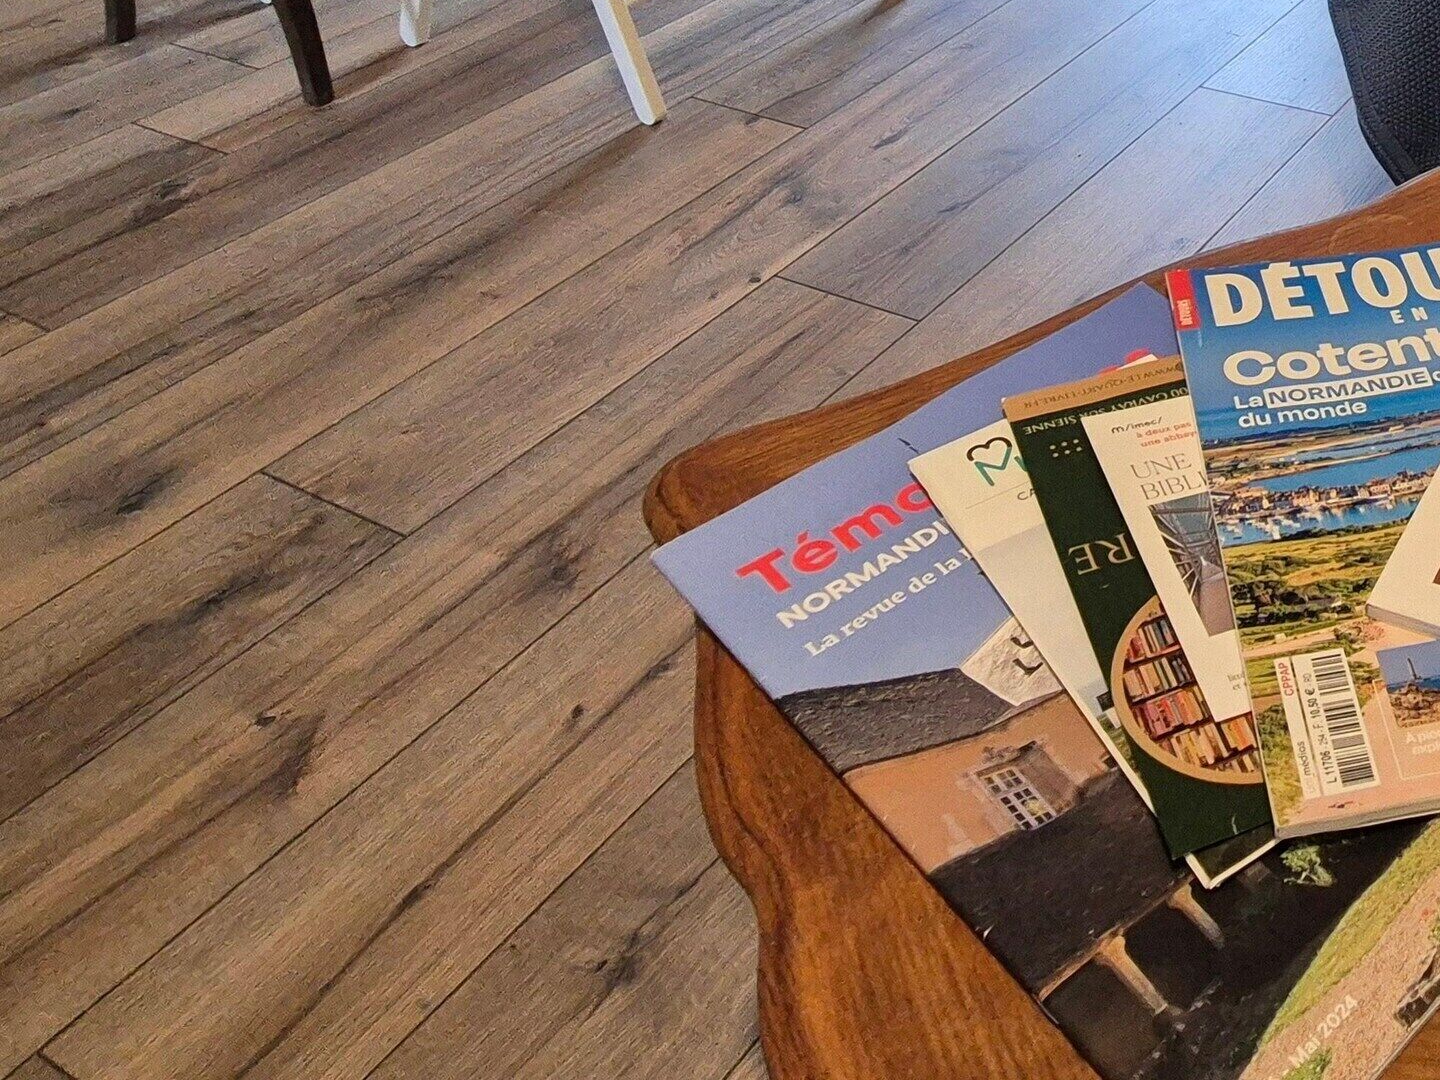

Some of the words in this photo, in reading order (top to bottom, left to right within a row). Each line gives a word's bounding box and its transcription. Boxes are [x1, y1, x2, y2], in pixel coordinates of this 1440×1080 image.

[1390, 307, 1428, 324] EN
[1233, 394, 1264, 410] La
[1268, 370, 1428, 405] NORMANDIE
[1022, 415, 1077, 436] SIENNE
[1238, 411, 1271, 428] du
[1277, 401, 1368, 423] monde
[1130, 453, 1192, 479] UNE
[803, 631, 840, 657] La
[840, 590, 908, 638] revue
[908, 571, 938, 594] de
[934, 556, 962, 576] la
[1278, 662, 1294, 696] CPPAP
[1307, 697, 1321, 719] 10,50
[1316, 994, 1359, 1039] 2024
